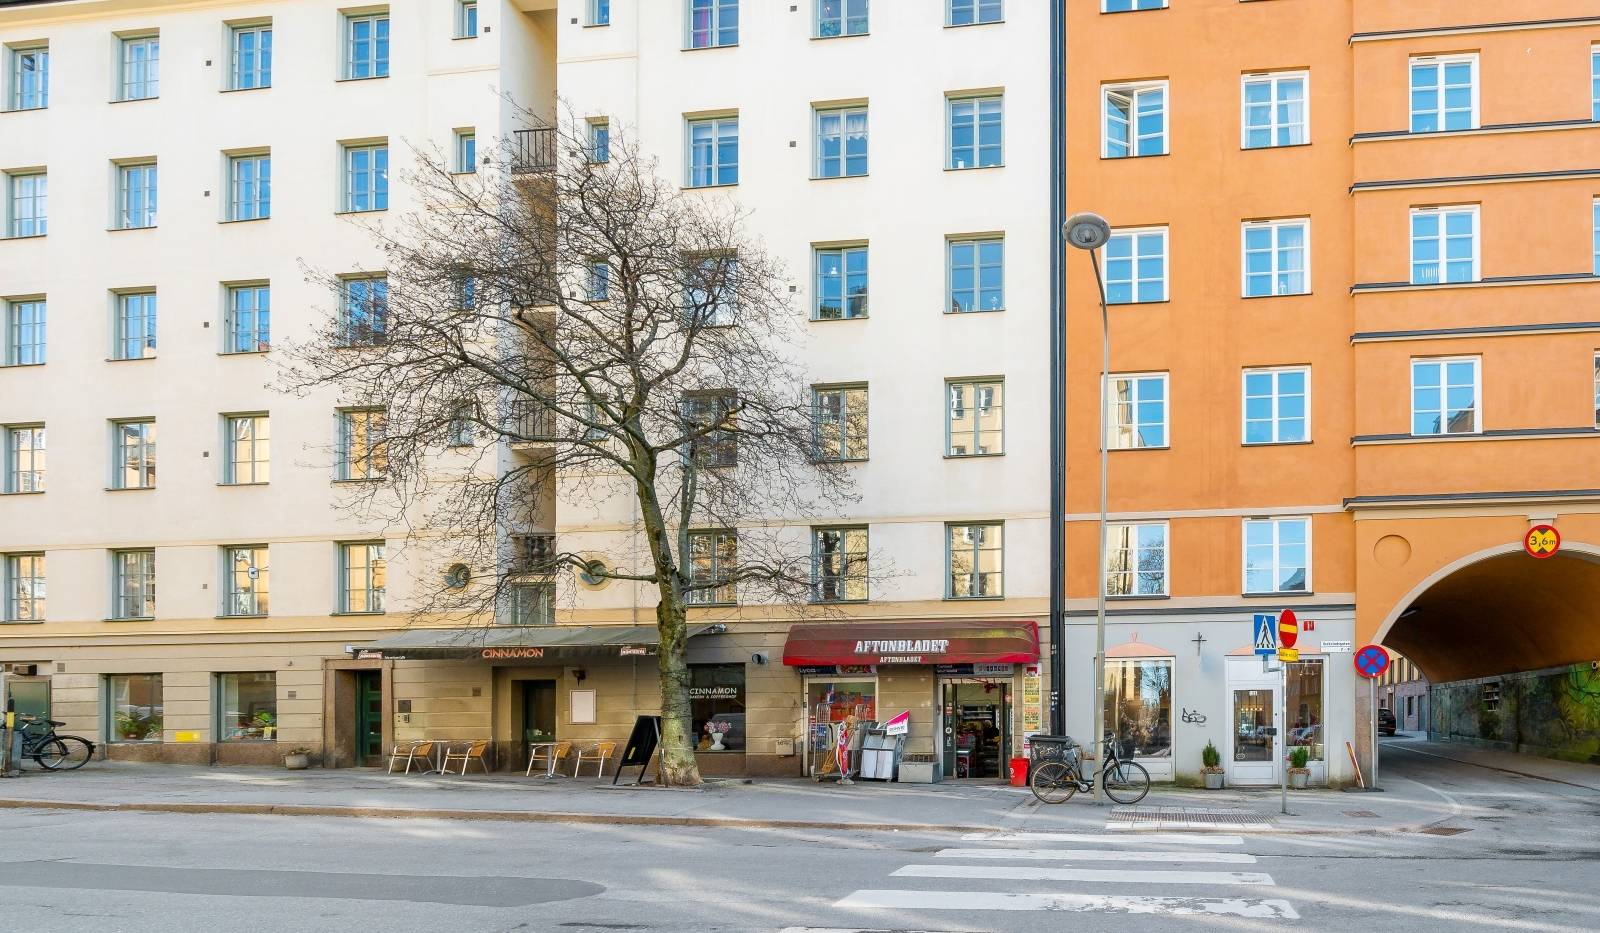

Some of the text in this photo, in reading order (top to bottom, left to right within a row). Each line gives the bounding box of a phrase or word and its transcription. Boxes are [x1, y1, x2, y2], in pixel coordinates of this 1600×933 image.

[481, 647, 545, 659] CINNAMON
[854, 639, 950, 655] AFTONBLADET
[689, 687, 737, 695] CINNAMON
